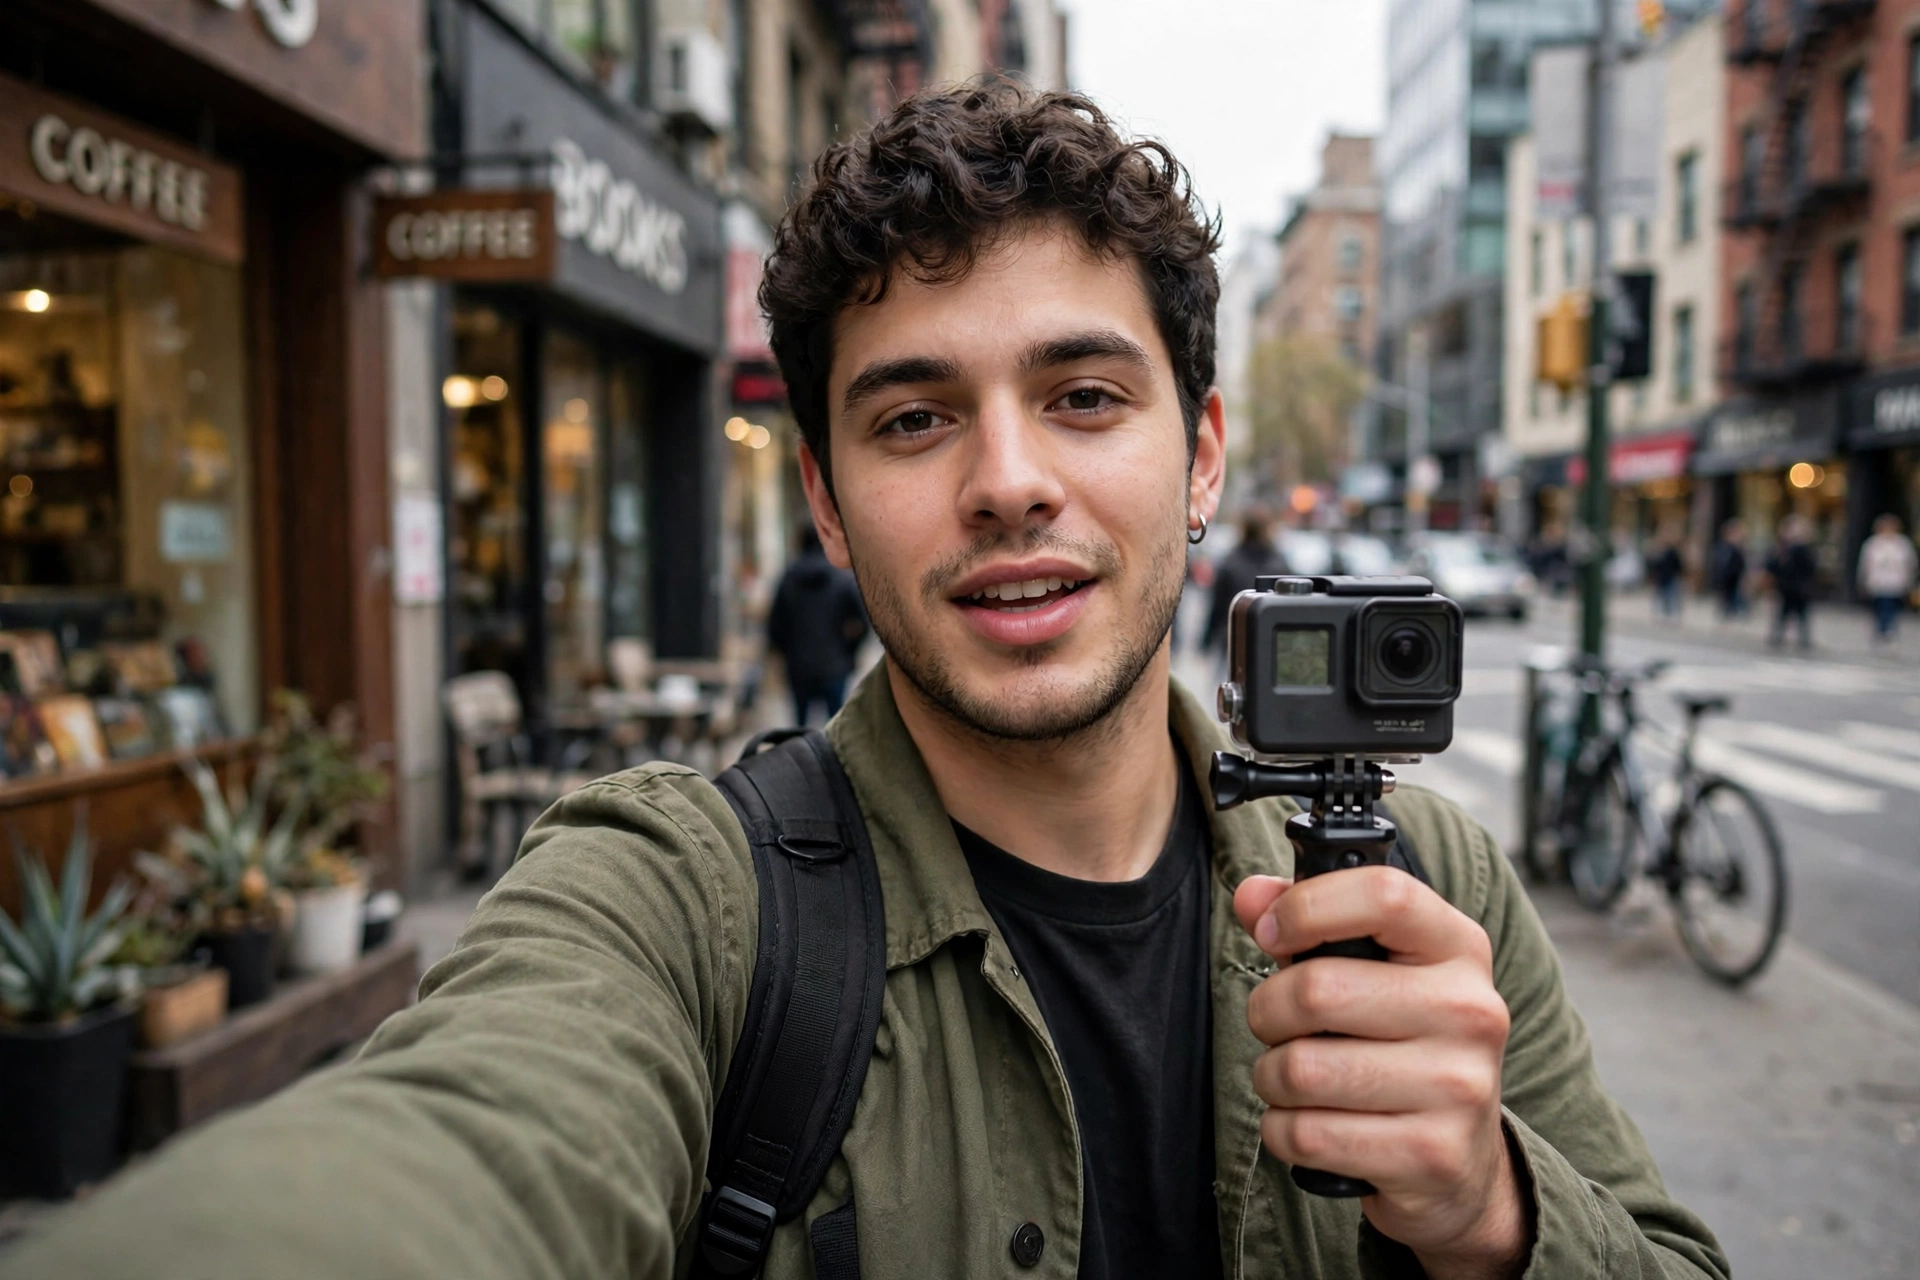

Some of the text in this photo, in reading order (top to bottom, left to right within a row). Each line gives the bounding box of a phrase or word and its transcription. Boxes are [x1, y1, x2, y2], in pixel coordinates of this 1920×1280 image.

[31, 115, 210, 231] COFFEE
[551, 138, 688, 293] BOOKS
[387, 209, 537, 261] COFFEE
